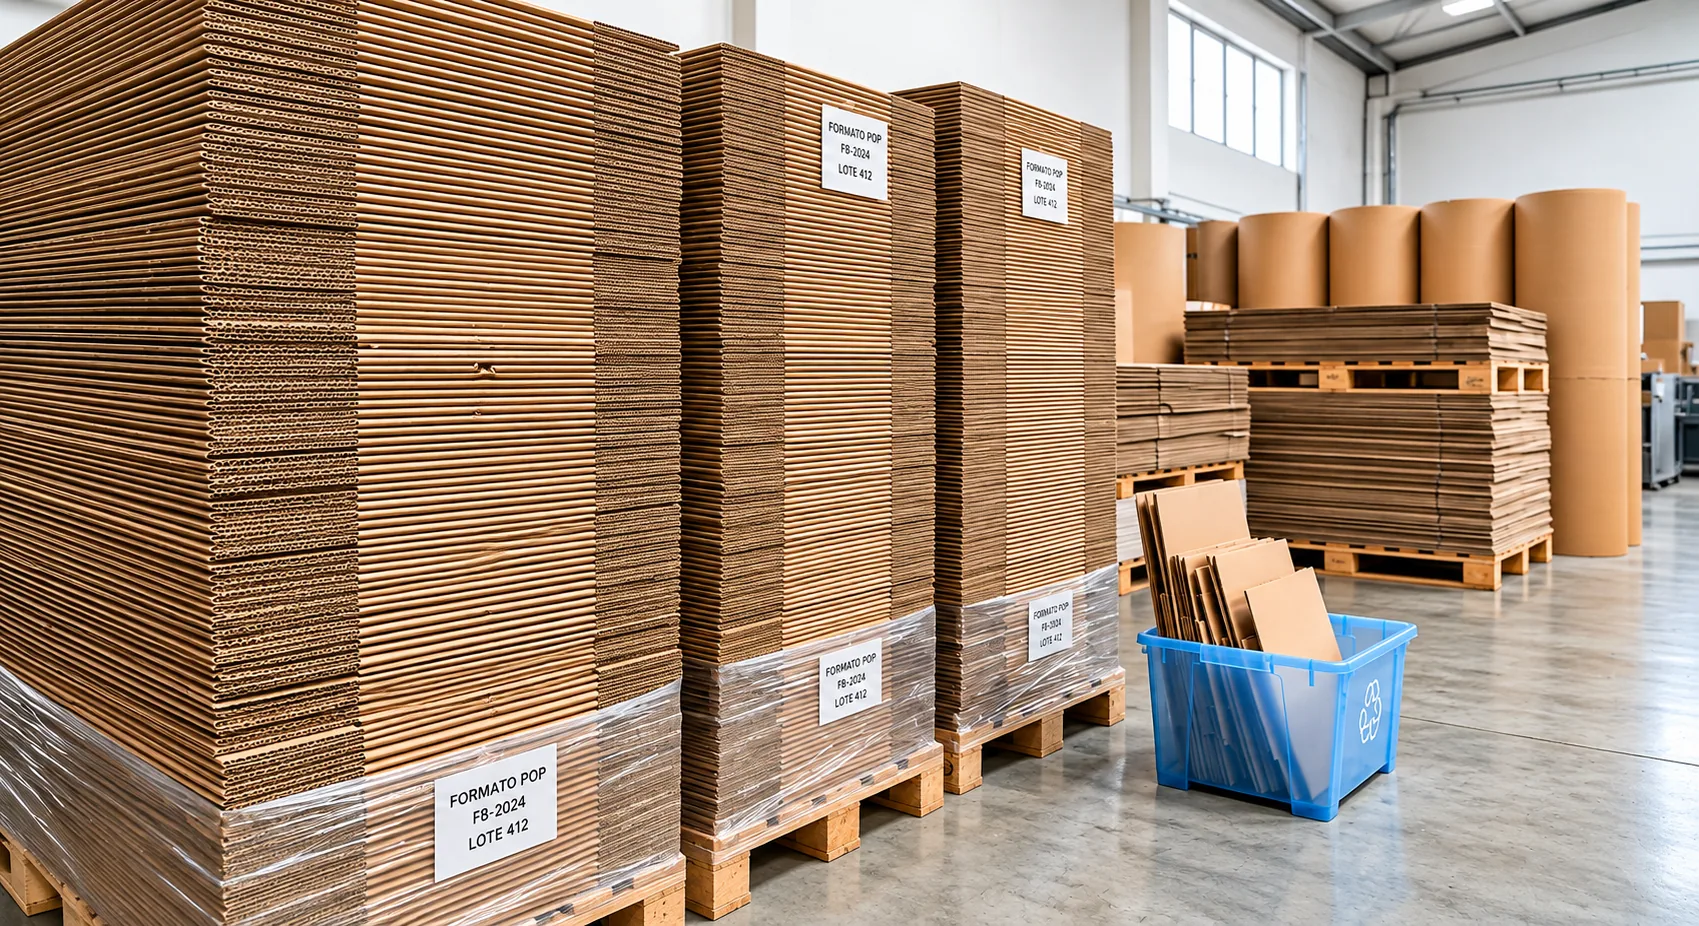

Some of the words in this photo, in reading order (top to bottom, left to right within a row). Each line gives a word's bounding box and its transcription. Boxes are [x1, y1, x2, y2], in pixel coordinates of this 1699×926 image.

[829, 121, 865, 140] FORMATO
[866, 131, 882, 143] POP
[838, 163, 858, 177] LOTE
[859, 169, 872, 181] 412
[1033, 195, 1047, 206] LOTE
[826, 658, 860, 677] FORMATO
[862, 652, 877, 665] POP
[834, 693, 853, 708] LOTE
[854, 689, 867, 700] 412
[450, 776, 517, 808] FORMATO
[520, 766, 547, 786] POP
[473, 795, 526, 824] F8-2024
[468, 827, 503, 851] LOTE
[506, 818, 529, 836] 412
